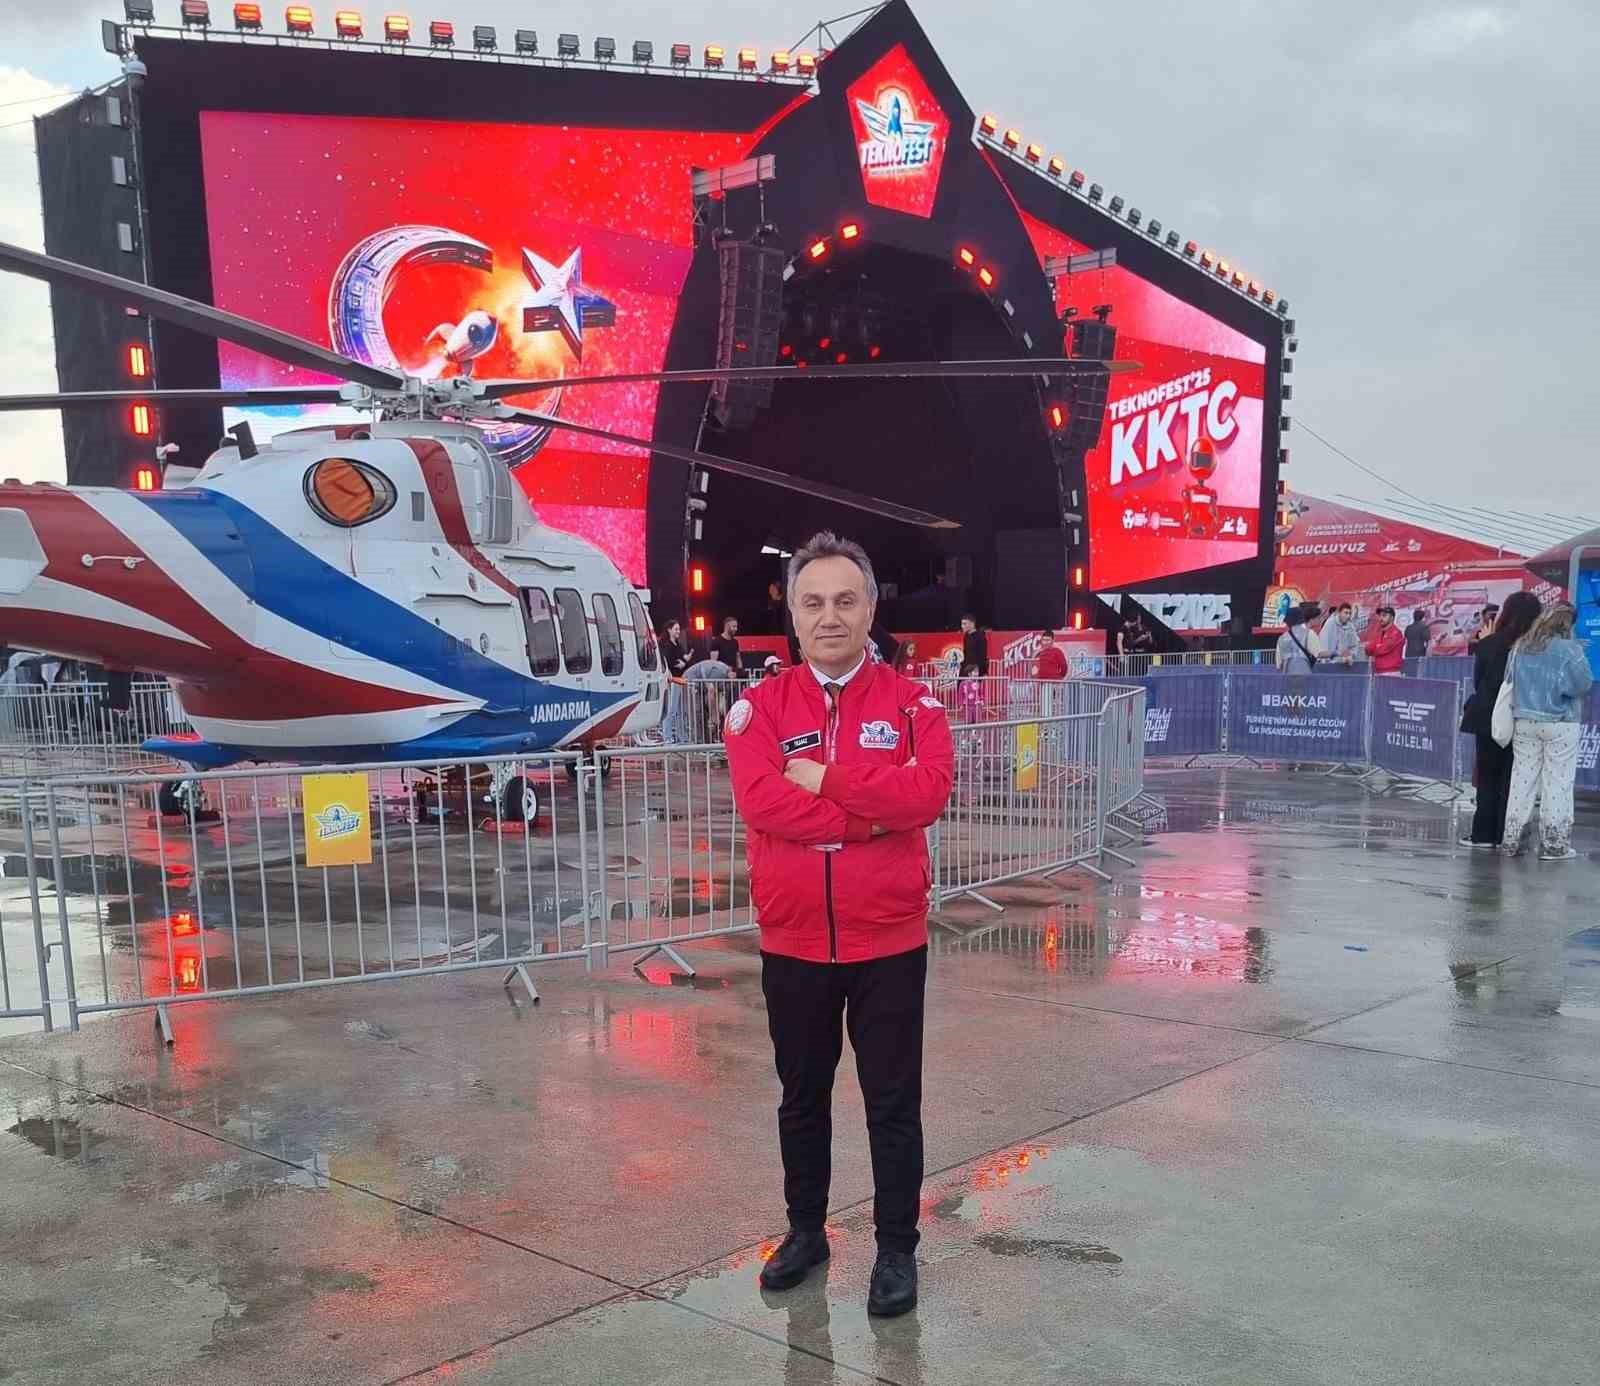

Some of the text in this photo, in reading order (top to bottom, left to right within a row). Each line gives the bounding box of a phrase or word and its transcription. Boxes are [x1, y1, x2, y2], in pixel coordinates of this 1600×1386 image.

[1109, 367, 1212, 421] TEKNOFEST'25
[1110, 380, 1237, 486] KKTC
[530, 700, 592, 724] JANDARMA
[1272, 695, 1327, 708] BAYKAR
